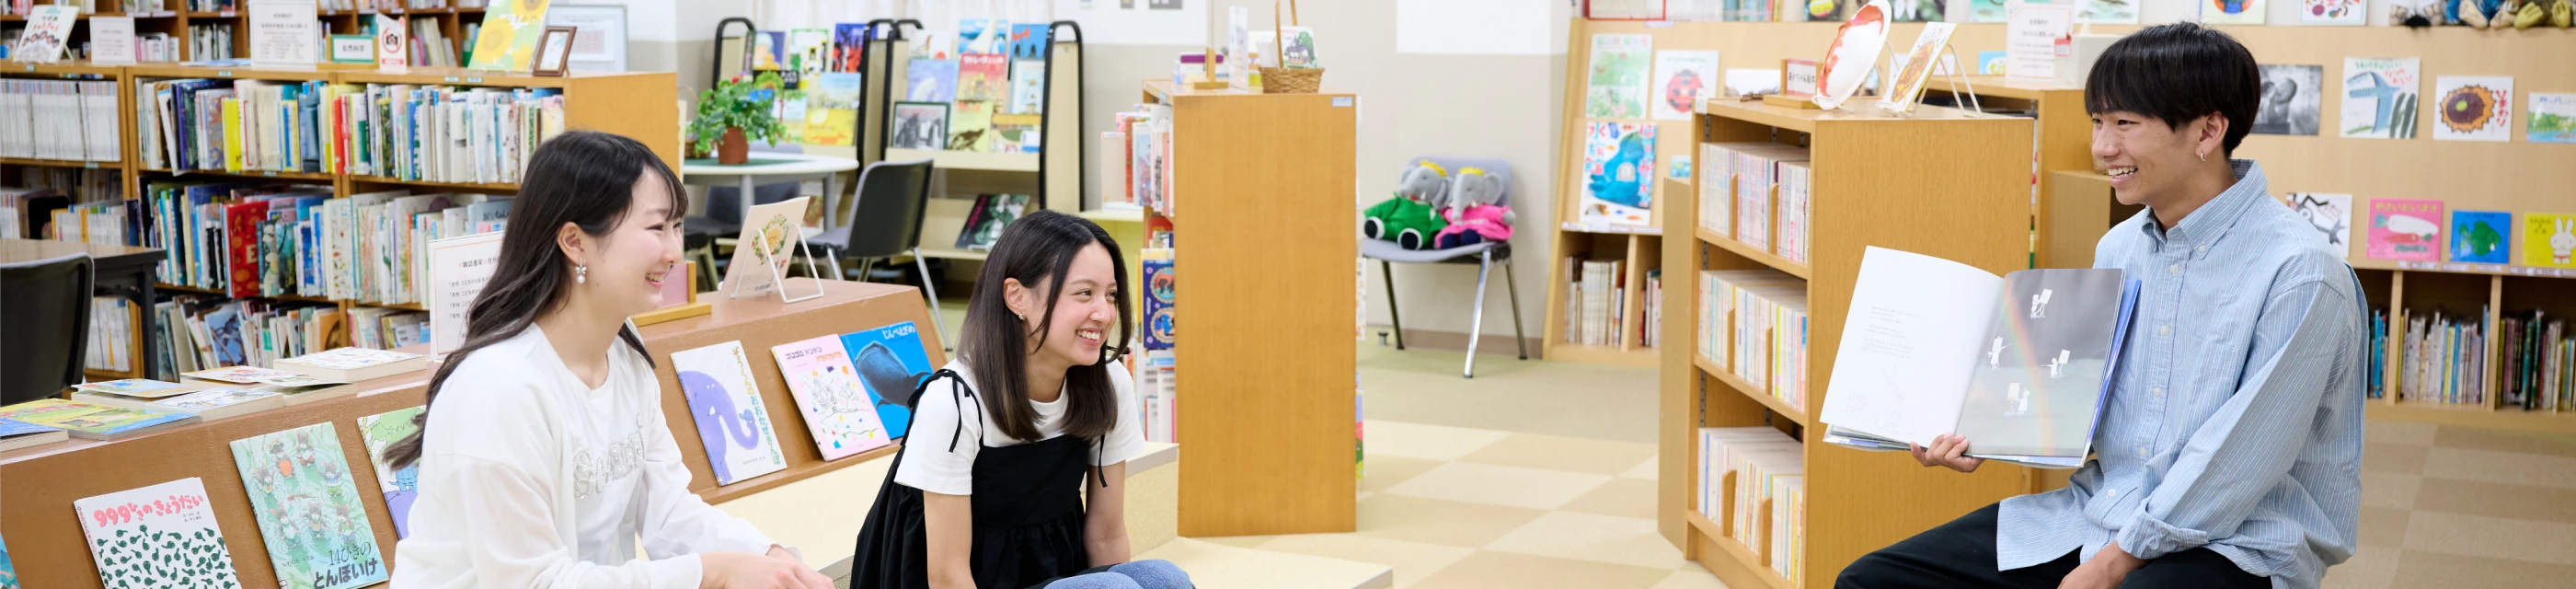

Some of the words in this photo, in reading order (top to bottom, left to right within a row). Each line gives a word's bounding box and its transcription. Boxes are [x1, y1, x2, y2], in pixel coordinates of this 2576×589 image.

[2495, 89, 2509, 128] ひまわり
[2375, 202, 2437, 214] やさいだいすき
[463, 259, 483, 268] 雑誌書架
[154, 494, 204, 517] きょうだい
[328, 542, 372, 566] 14ひきの
[314, 558, 378, 589] とんぼいけ
